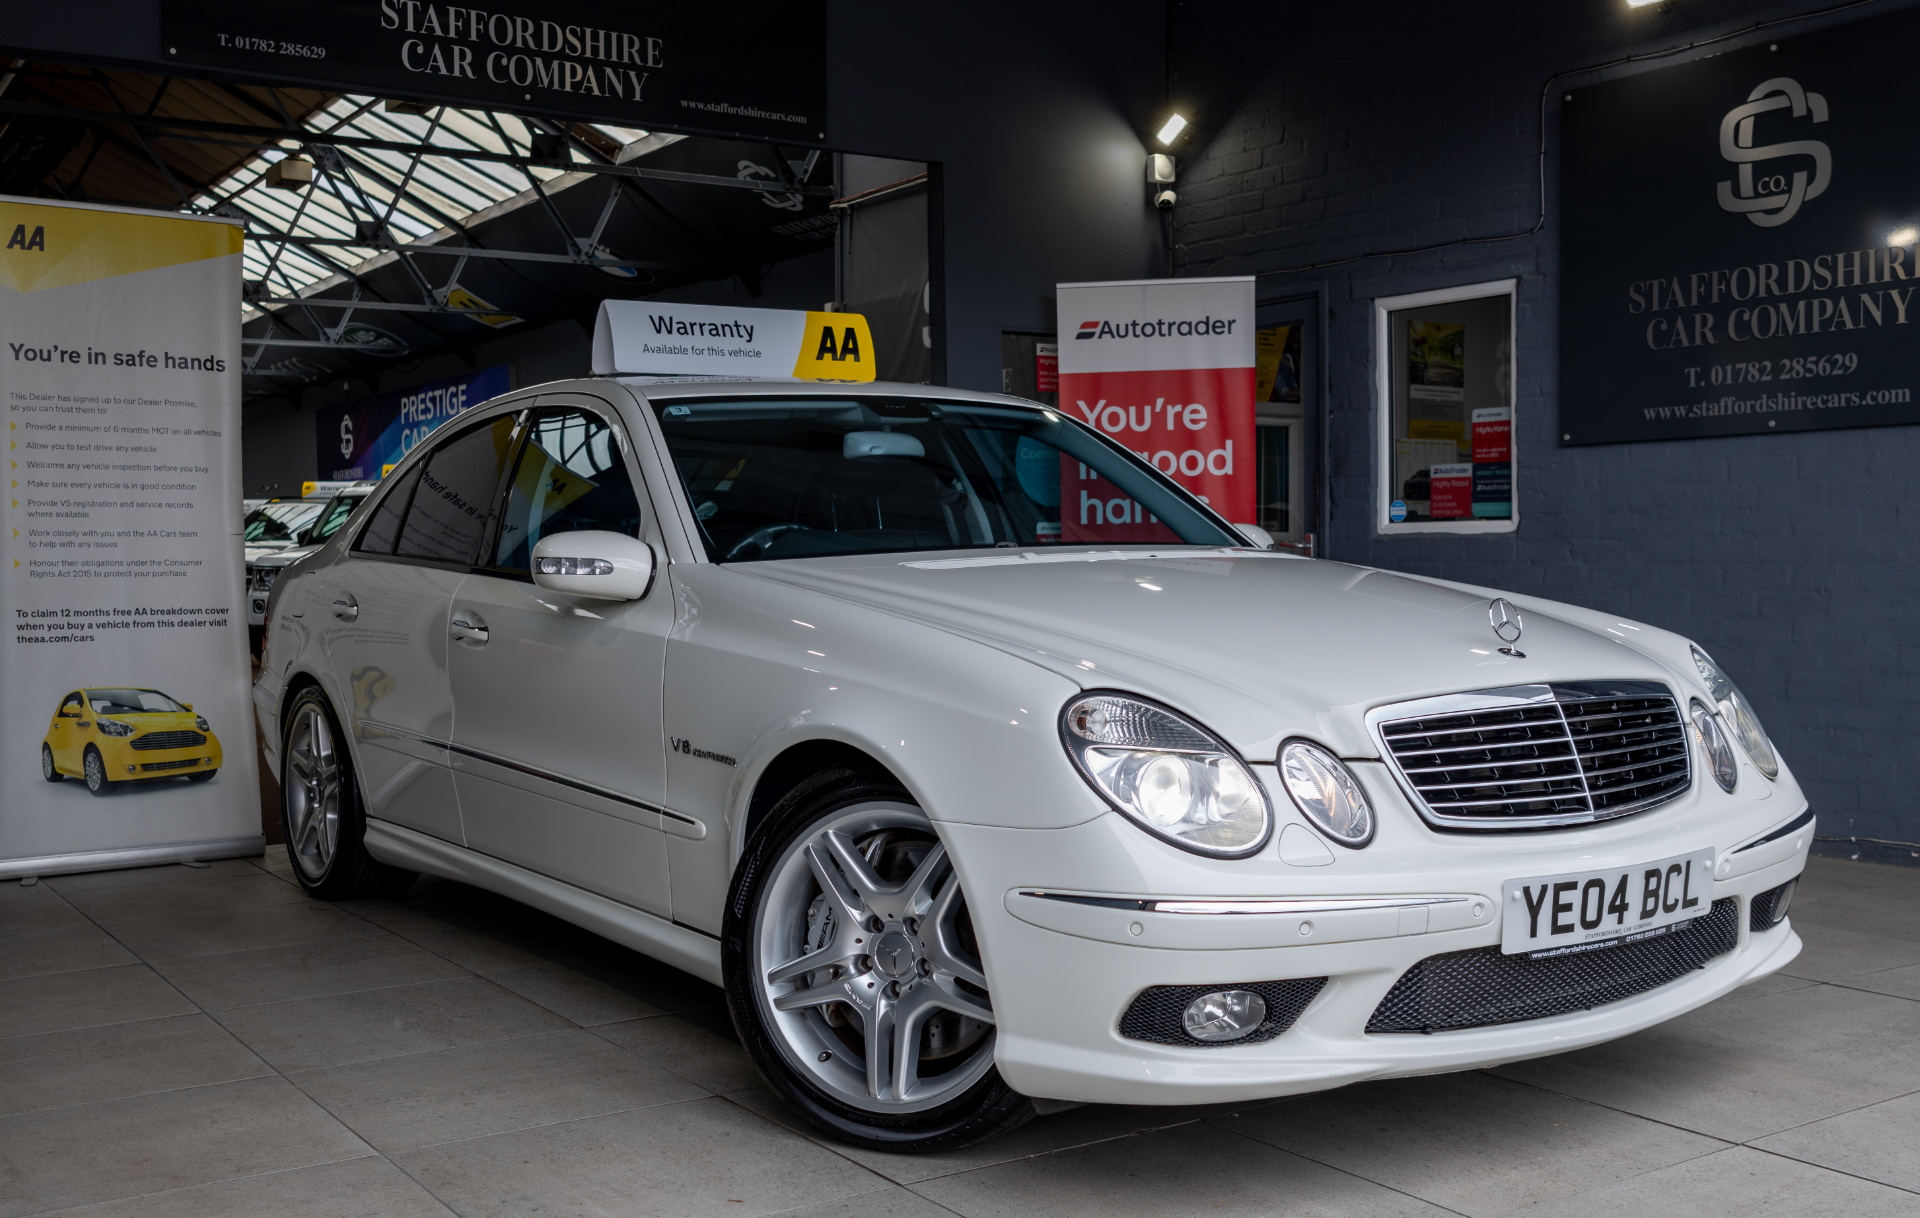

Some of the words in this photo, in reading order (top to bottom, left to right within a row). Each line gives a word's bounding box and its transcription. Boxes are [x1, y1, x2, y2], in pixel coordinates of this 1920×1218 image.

[380, 0, 664, 68] STAFFORDSHIRE
[218, 34, 232, 47] T.
[235, 36, 275, 52] 01782
[279, 42, 326, 59] 285629
[401, 39, 477, 79] CAR
[487, 51, 650, 101] COMPANY
[681, 99, 807, 124] www.staffordshirecars.com
[1758, 175, 1788, 194] CO.
[6, 224, 44, 251] AA
[1098, 316, 1236, 339] Autotrader
[1646, 313, 1718, 351] CAR
[1727, 287, 1916, 342] COMPANY
[649, 315, 754, 342] Warranty
[816, 326, 861, 362] AA
[88, 347, 106, 364] in
[113, 350, 158, 367] safe
[164, 352, 226, 372] hands
[642, 344, 688, 356] Available
[691, 345, 706, 356] for
[707, 346, 725, 357] this
[727, 347, 762, 358] vehicle
[1685, 367, 1706, 388] T.
[1711, 359, 1772, 386] 01782
[1778, 352, 1858, 381] 285629
[73, 395, 99, 404] signed
[102, 396, 111, 405] up
[401, 384, 467, 424] PRESTIGE
[1643, 388, 1911, 421] www.staffordshirecars.com
[121, 426, 149, 434] months
[1021, 448, 1055, 459] Come
[1139, 440, 1232, 476] ood
[27, 461, 64, 470] Welcome
[112, 463, 151, 472] inspection
[195, 465, 209, 473] buy
[1433, 480, 1450, 488] Highly
[73, 500, 117, 510] registration
[53, 530, 79, 538] closely
[40, 540, 57, 549] help
[81, 559, 124, 568] obligations
[30, 570, 56, 579] Rights
[104, 570, 131, 579] protect
[152, 570, 187, 579] purchase
[16, 610, 28, 618] To
[31, 609, 57, 617] claim
[73, 608, 110, 617] months
[113, 608, 132, 616] free
[150, 607, 202, 615] breakdown
[17, 622, 44, 630] when
[67, 621, 85, 631] buy
[95, 620, 130, 629] vehicle
[133, 620, 155, 628] from
[157, 619, 175, 628] this
[177, 619, 207, 627] dealer
[209, 618, 227, 627] visit
[17, 634, 94, 644] theaa.com/cars
[671, 736, 691, 754] V8
[1523, 874, 1629, 938] YE04
[1640, 860, 1699, 920] BCL
[1585, 928, 1622, 940] STAFFORDSHIRE
[1633, 922, 1653, 931] COMPANY
